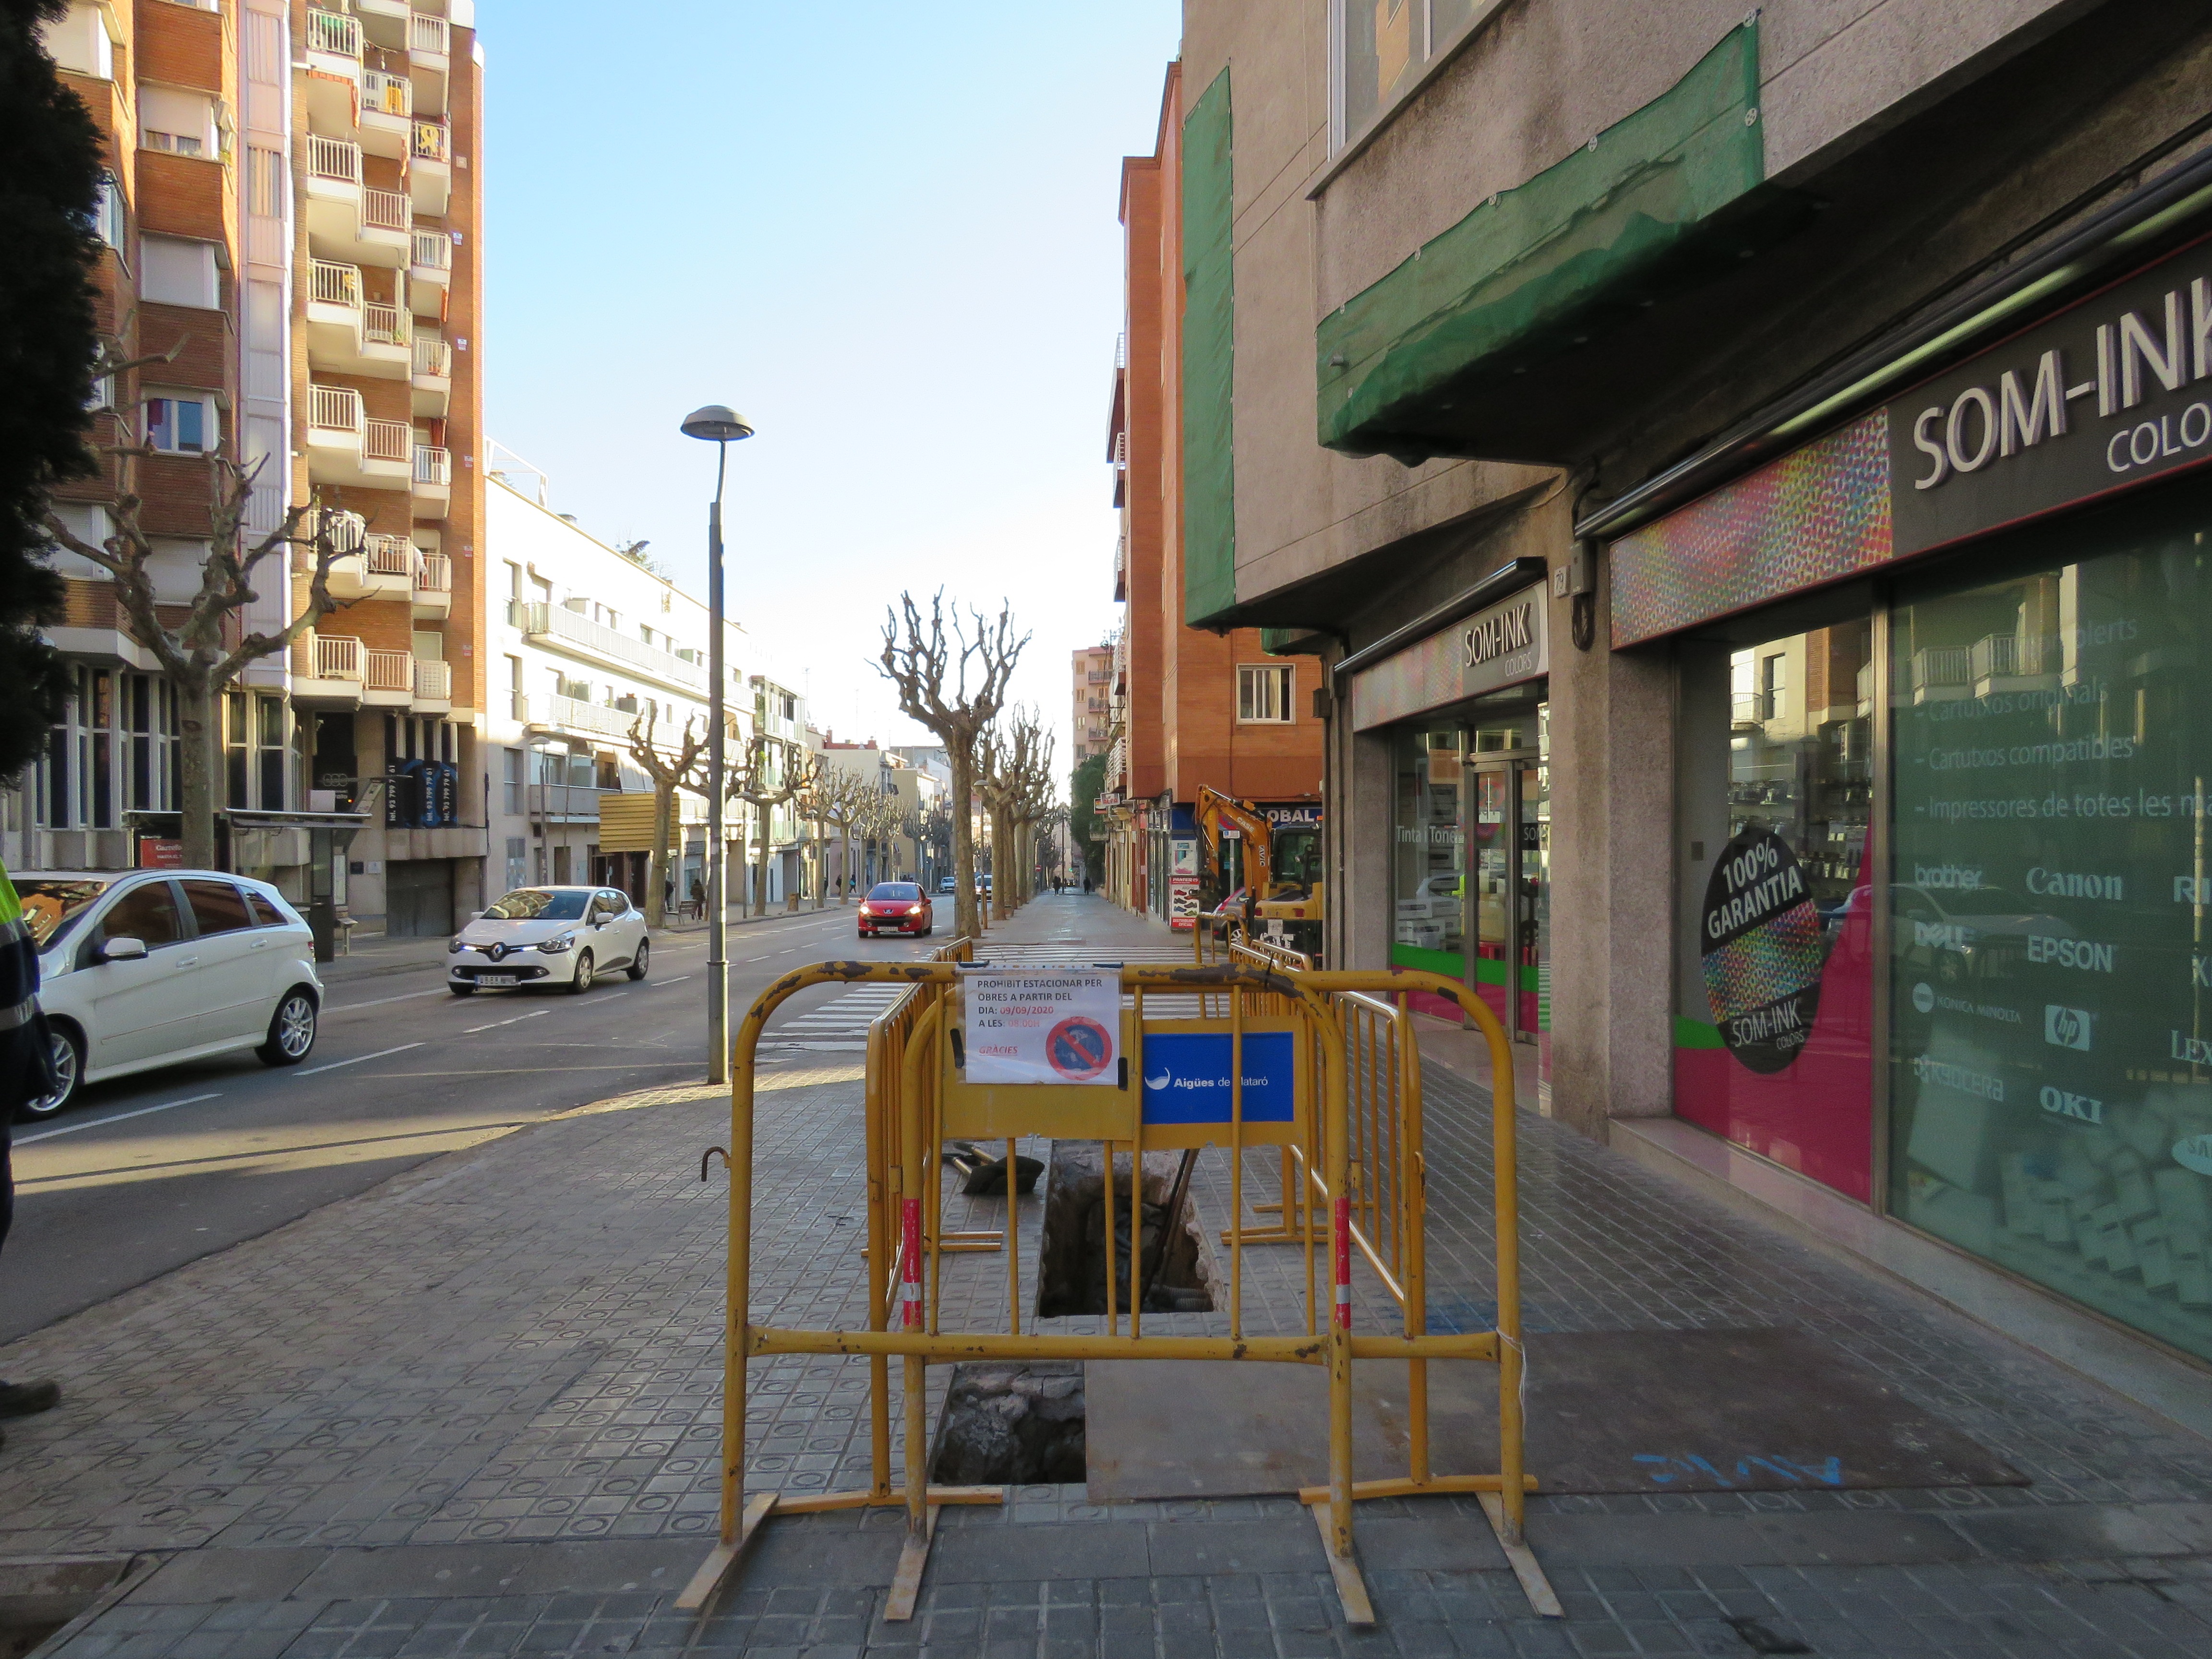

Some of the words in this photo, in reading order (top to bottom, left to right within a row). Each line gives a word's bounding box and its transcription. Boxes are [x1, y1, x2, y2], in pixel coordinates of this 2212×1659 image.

[1465, 602, 1528, 667] SOM-INK
[1505, 652, 1532, 677] COLORS
[1929, 747, 2006, 769] Cartutxos
[2009, 731, 2133, 769] compatibles
[389, 800, 396, 808] 93
[1929, 796, 2036, 823] Impressores
[2043, 791, 2068, 817] de
[2076, 792, 2131, 817] totes
[2140, 788, 2172, 817] les
[1237, 817, 1255, 833] CASE
[1267, 809, 1314, 823] OBAL
[1396, 826, 1420, 843] Tinta
[1723, 837, 1778, 893] 100%
[1914, 862, 1982, 890] brother
[2026, 867, 2123, 901] Canon
[1708, 866, 1803, 939] GARANTIA
[2028, 935, 2115, 974] EPSON
[977, 980, 1021, 988] PROHIBIT
[1023, 979, 1082, 988] ESTACIONAR
[1085, 979, 1103, 987] PER
[978, 993, 1008, 1001] OBRES
[1010, 993, 1017, 1001] A
[1020, 993, 1053, 1001] PARTIR
[1055, 992, 1072, 1001] DEL
[978, 1006, 997, 1015] DIA:
[1000, 1006, 1054, 1015] 09/09/2020
[987, 1019, 1005, 1027] LES:
[1732, 998, 1802, 1048] SOM-INK
[979, 1045, 1018, 1055] GRÀCIES
[1776, 1030, 1804, 1050] COLORS
[1174, 1078, 1214, 1090] Aigües
[1218, 1077, 1230, 1086] de
[1240, 1076, 1268, 1086] ataró
[2039, 1085, 2102, 1125] OKI
